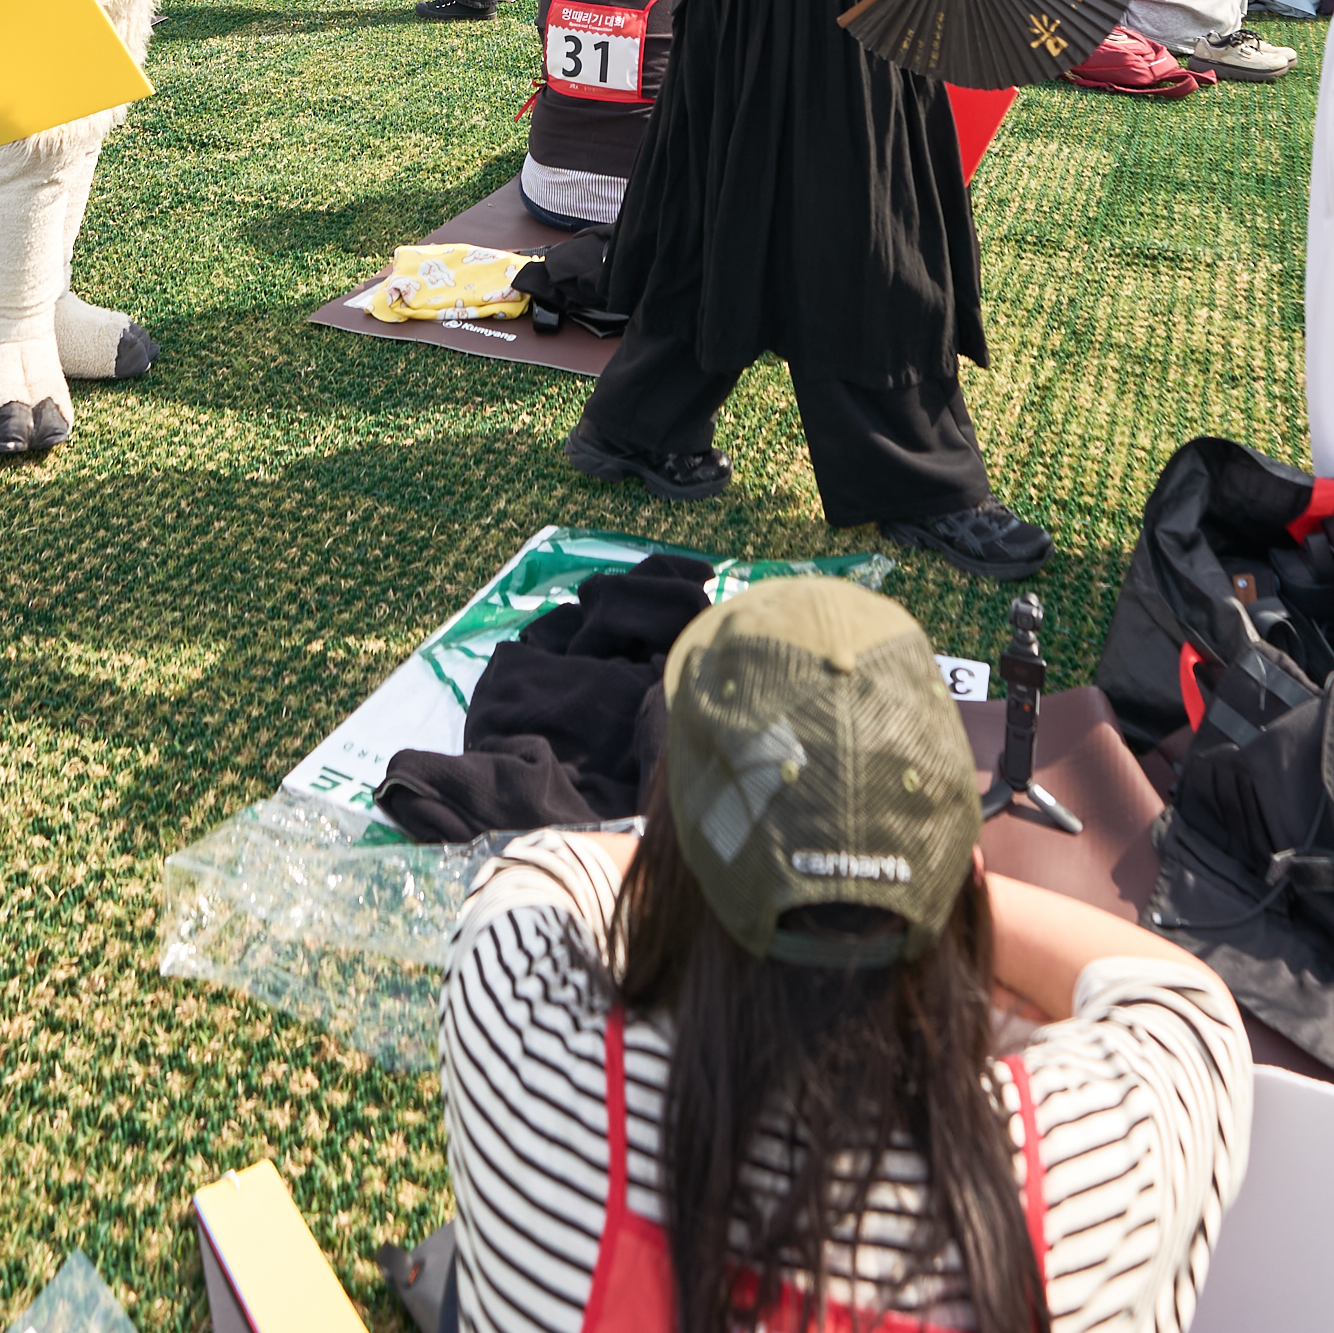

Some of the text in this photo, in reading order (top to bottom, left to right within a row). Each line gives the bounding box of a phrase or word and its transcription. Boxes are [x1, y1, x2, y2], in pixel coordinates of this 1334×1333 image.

[562, 8, 626, 29] 멍때리기 대회
[562, 34, 610, 83] 31
[462, 322, 517, 342] Kumyang
[792, 850, 912, 883] carhartt
